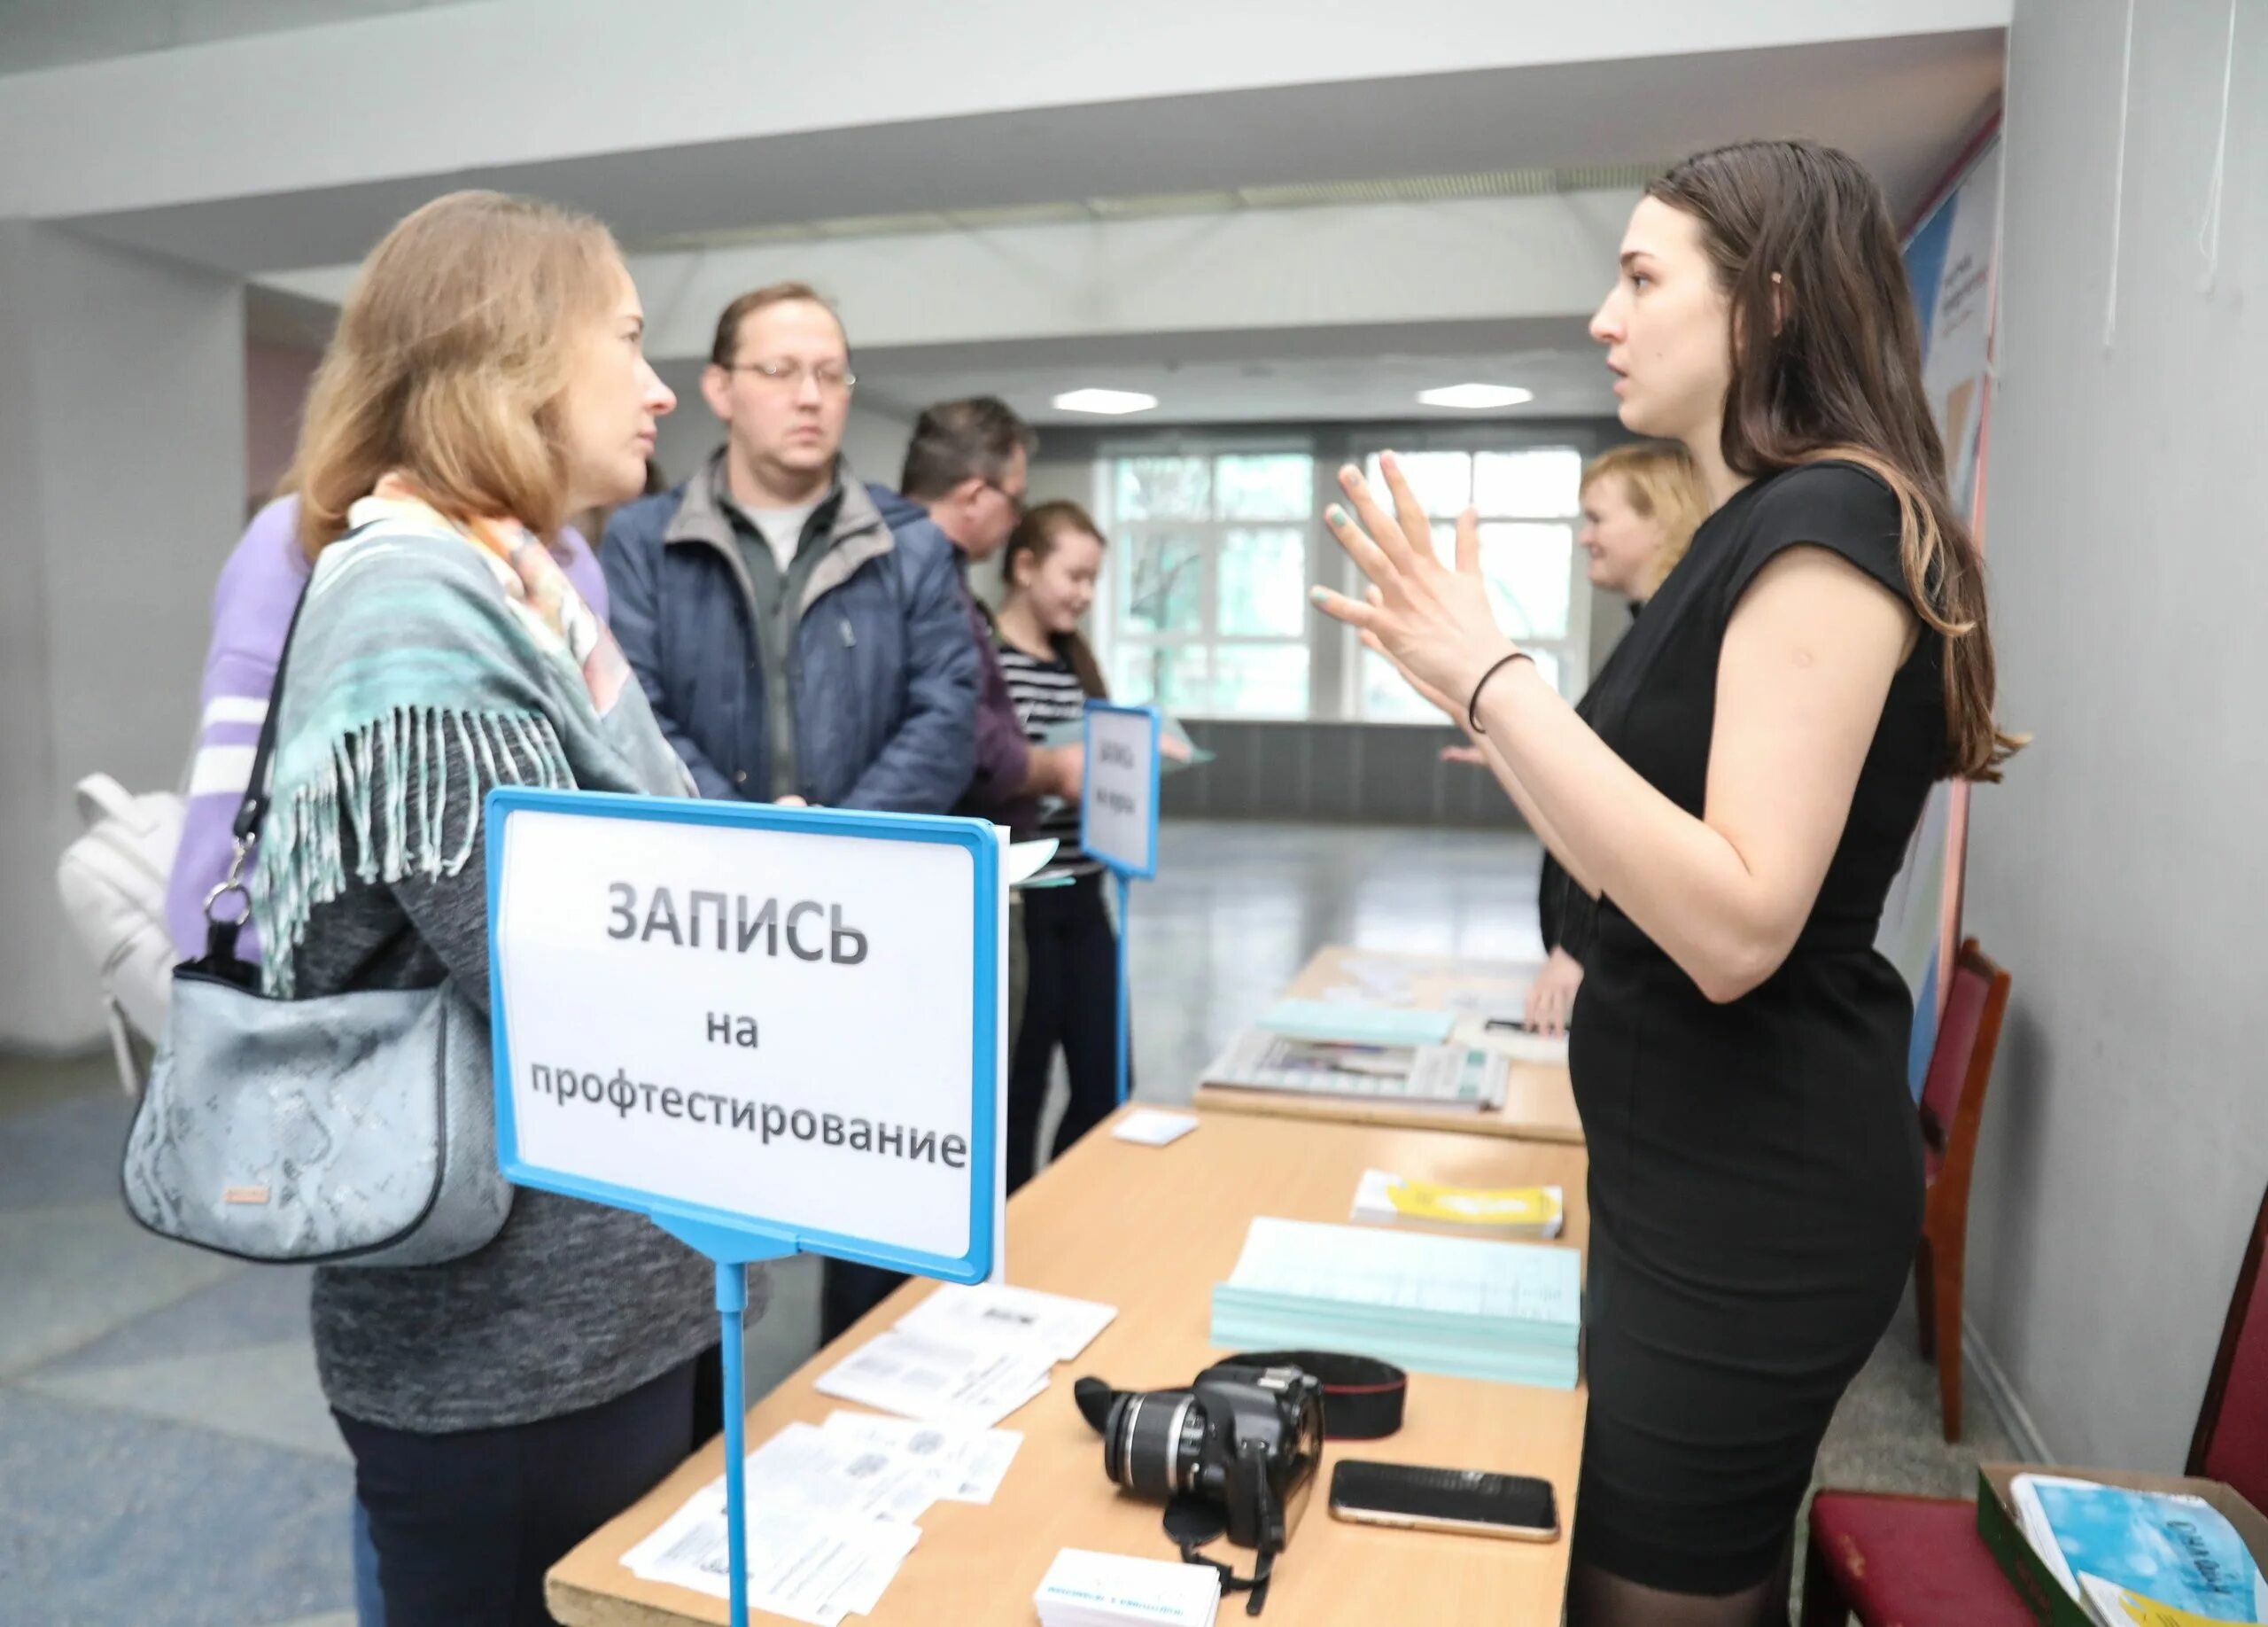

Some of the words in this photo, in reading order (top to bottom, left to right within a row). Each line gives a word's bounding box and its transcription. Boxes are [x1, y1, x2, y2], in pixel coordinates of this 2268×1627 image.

[607, 882, 869, 966] ЗАПИСЬ
[706, 1011, 759, 1049] на
[532, 1064, 967, 1169] профтестирование
